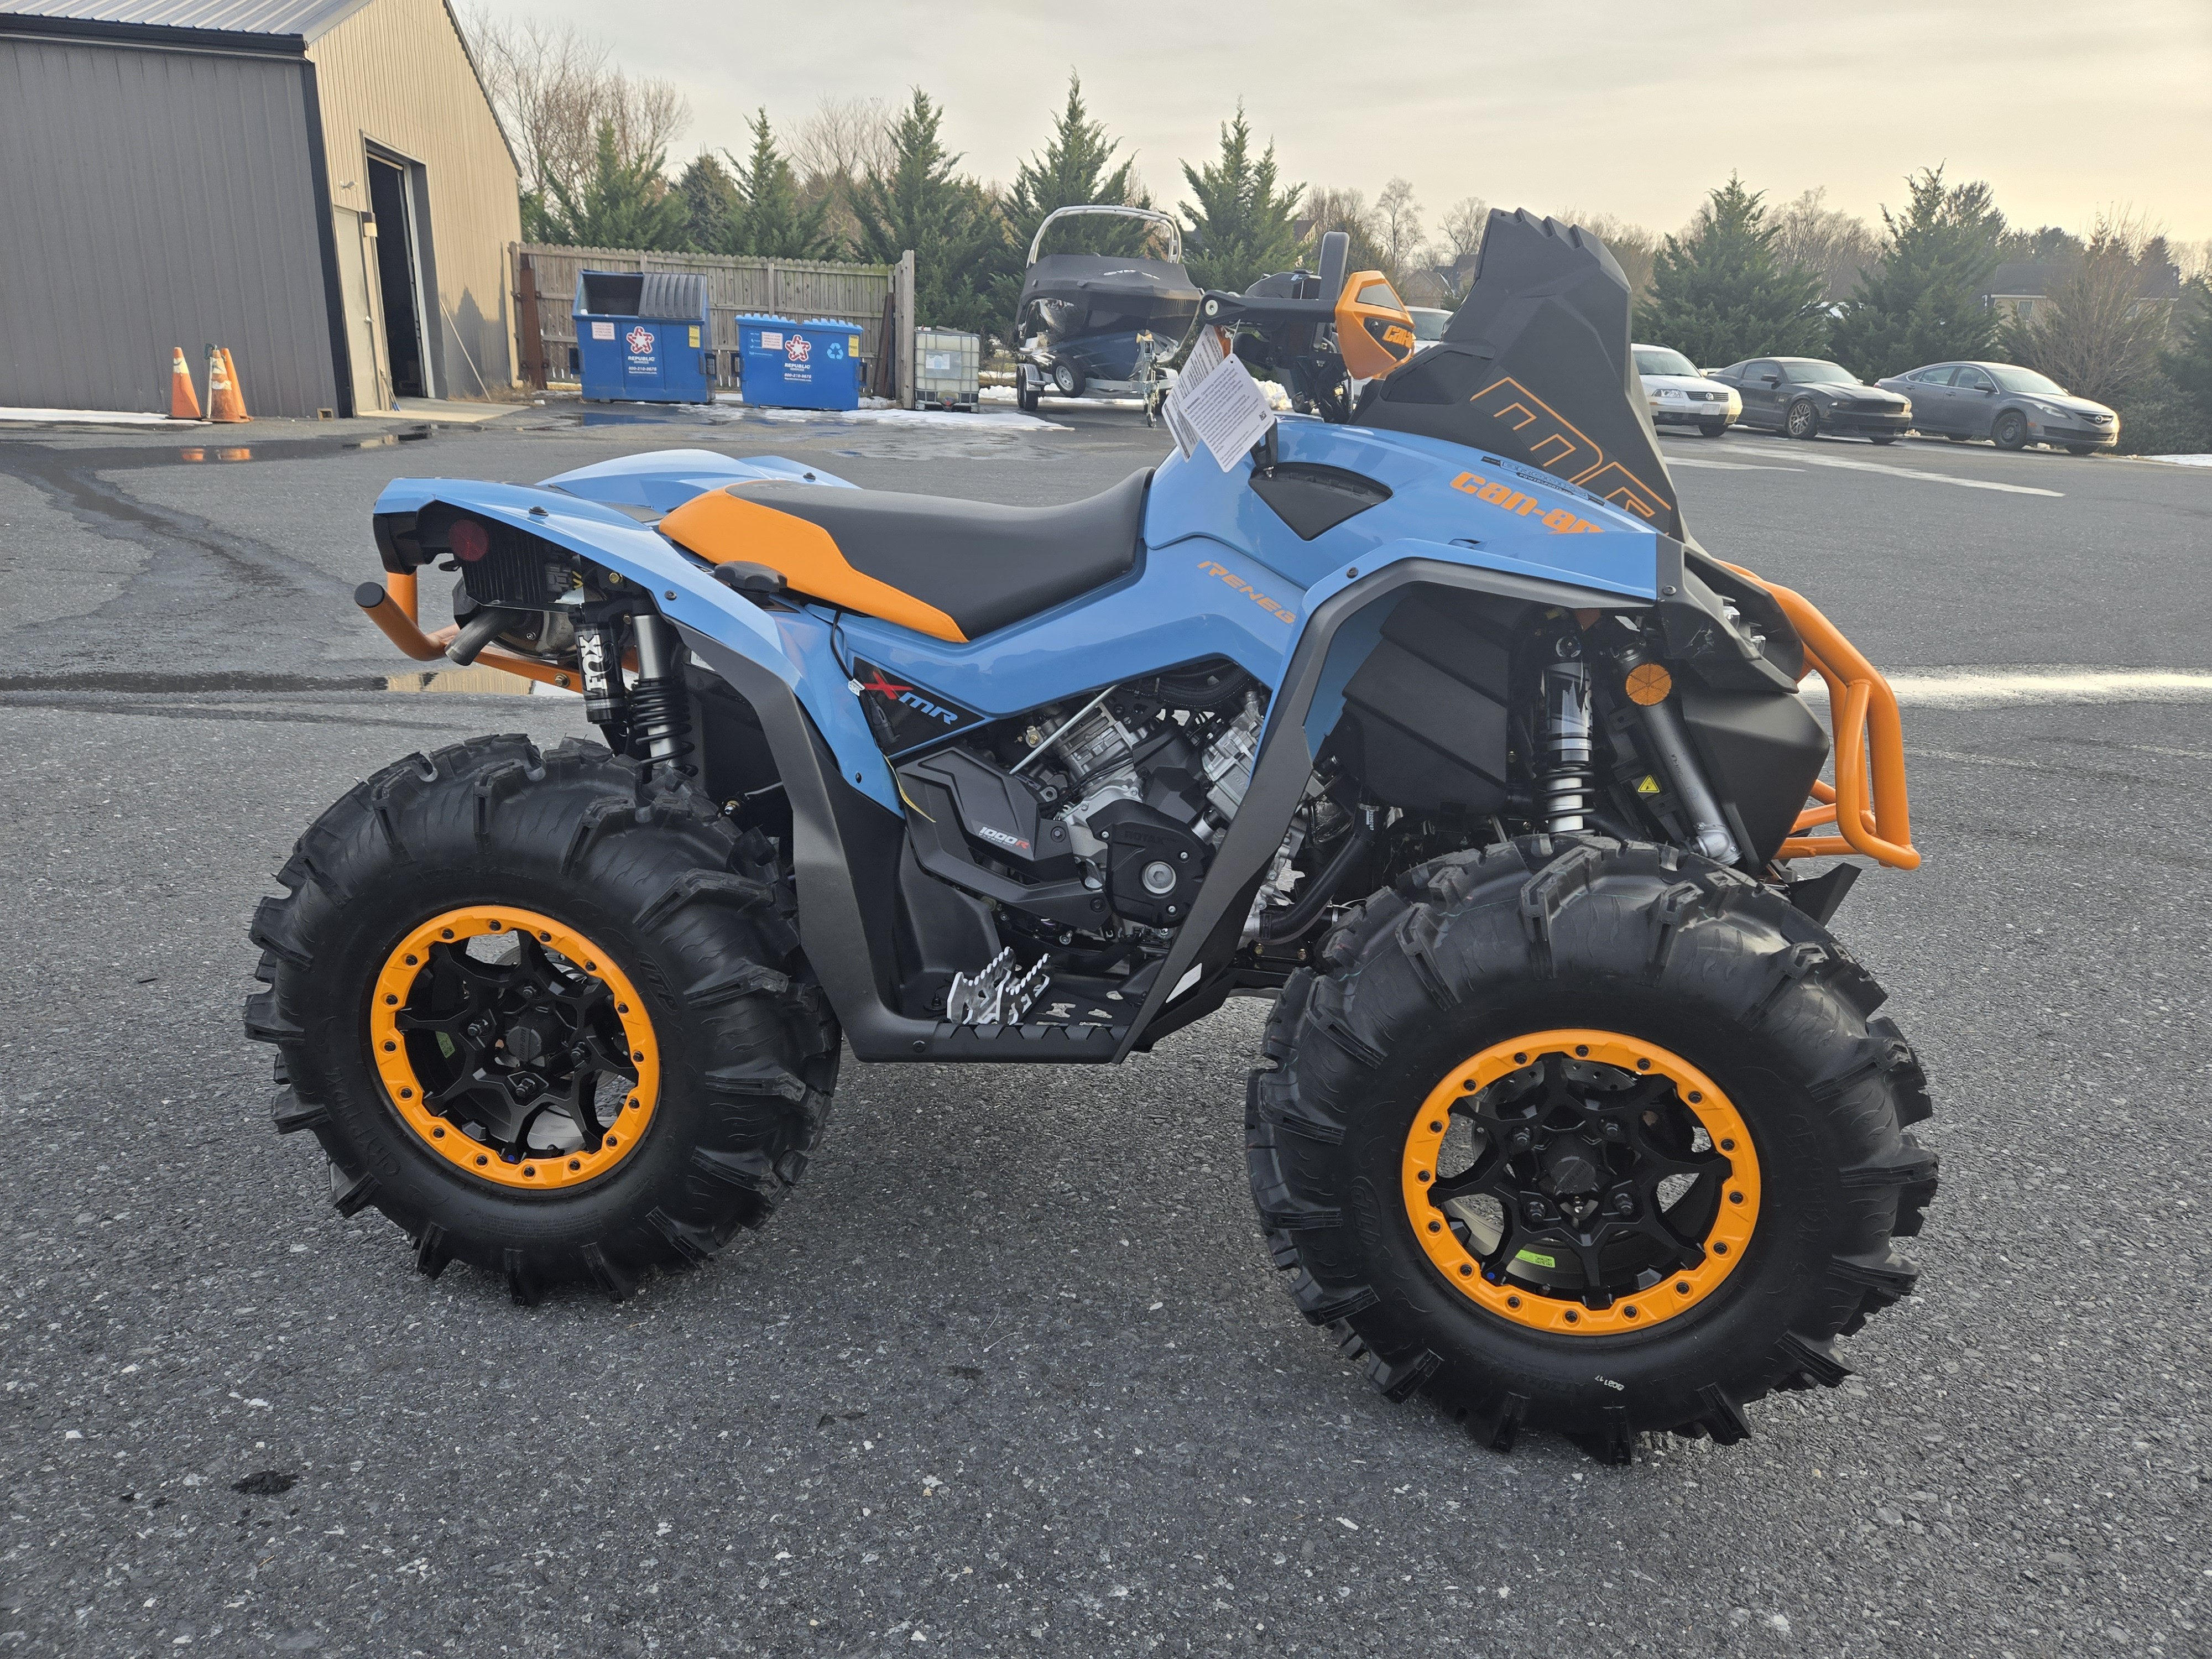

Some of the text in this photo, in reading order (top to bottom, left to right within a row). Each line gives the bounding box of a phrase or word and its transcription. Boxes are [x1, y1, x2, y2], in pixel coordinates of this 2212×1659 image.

[579, 634, 608, 691] FOX
[979, 826, 1030, 849] 1000R
[638, 954, 682, 1014] ITP
[1350, 1185, 1381, 1245] ITP
